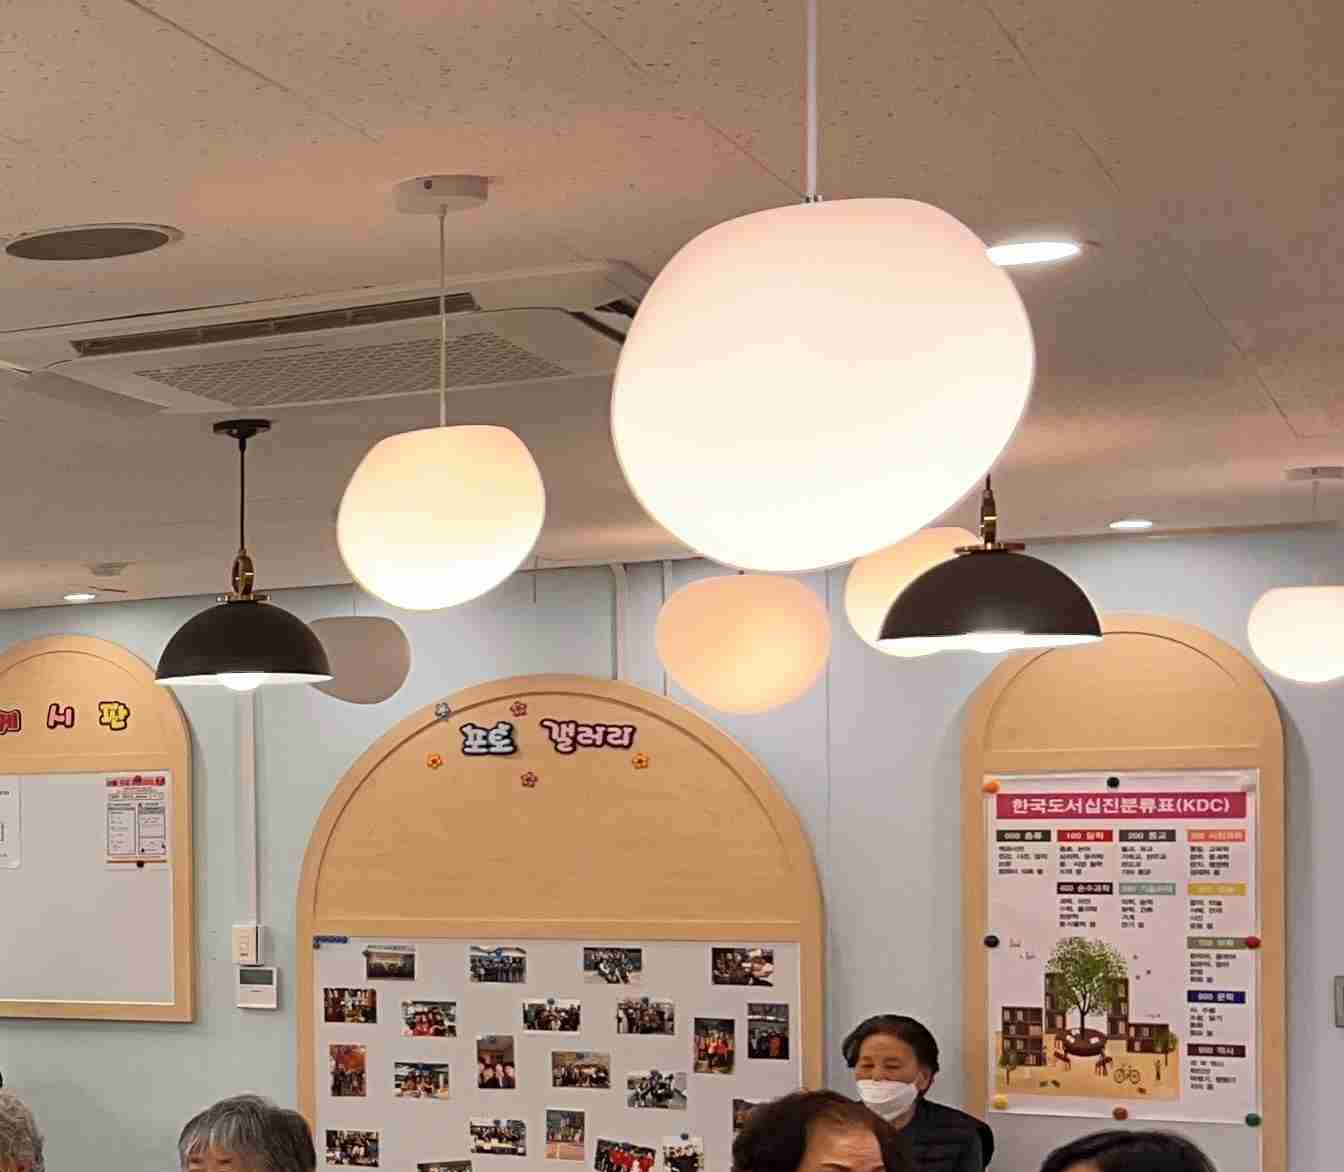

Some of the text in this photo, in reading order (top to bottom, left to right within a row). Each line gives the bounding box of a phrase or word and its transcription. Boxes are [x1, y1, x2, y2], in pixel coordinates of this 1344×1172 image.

[460, 718, 637, 756] 포토 갤러리
[1012, 796, 1231, 815] 한국도서십진분류표(KDC)
